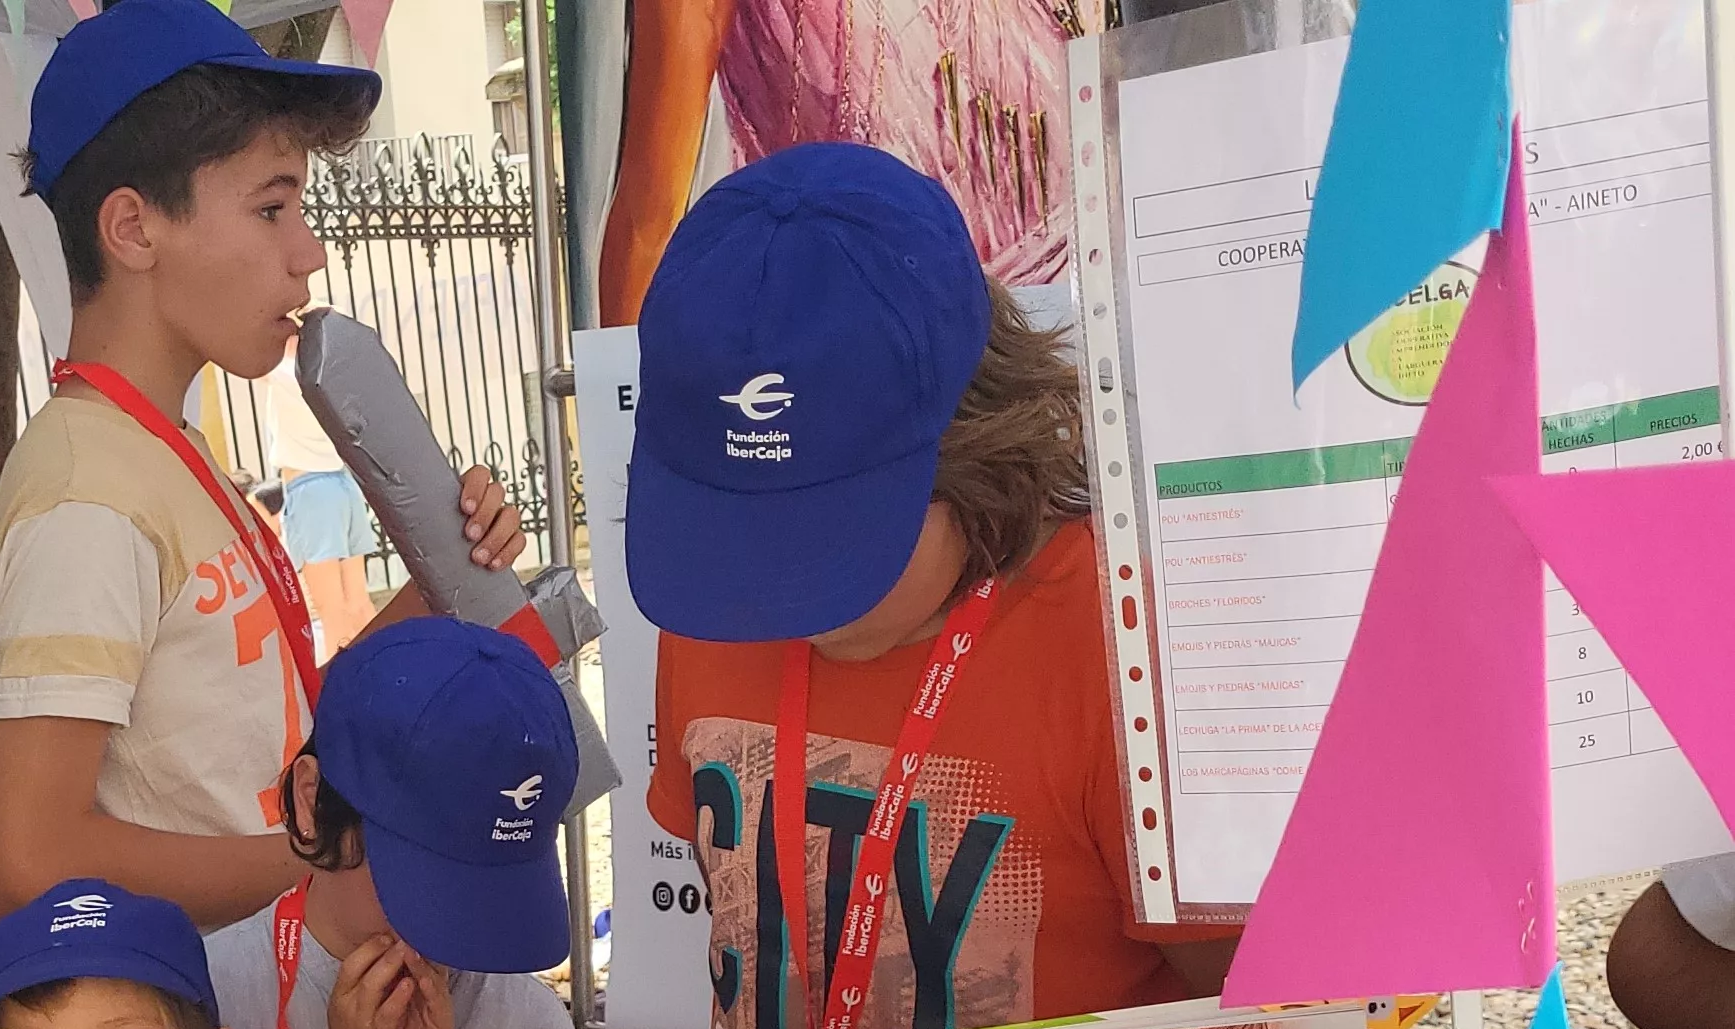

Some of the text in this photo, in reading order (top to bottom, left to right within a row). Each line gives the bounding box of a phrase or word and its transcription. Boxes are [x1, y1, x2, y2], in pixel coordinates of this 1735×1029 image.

[1566, 184, 1638, 213] AINETO
[1217, 239, 1306, 268] COOPERA
[1394, 279, 1470, 306] ELGA
[1541, 410, 1607, 432] ANTIDADES
[1650, 413, 1698, 432] PRECIOS
[726, 429, 790, 443] Fundación
[1548, 433, 1594, 450] HECHAS
[1681, 442, 1713, 461] 2,00
[1159, 481, 1222, 496] PRODUCTOS
[1162, 513, 1180, 525] POU
[1165, 557, 1184, 568] POU
[1168, 598, 1211, 610] BROCHES
[1171, 642, 1204, 652] EMOJIS
[1205, 641, 1212, 651] Y
[1578, 646, 1587, 660] 8
[913, 662, 942, 716] Fundación
[1208, 684, 1215, 693] Y
[1576, 690, 1594, 705] 10
[1178, 726, 1220, 736] LECHUGA
[1273, 724, 1286, 733] DE
[1288, 723, 1300, 733] LA
[1578, 734, 1596, 749] 25
[869, 783, 893, 837] Fundación
[495, 817, 534, 829] Fundación
[651, 841, 683, 860] Más
[842, 904, 861, 955] Fundación
